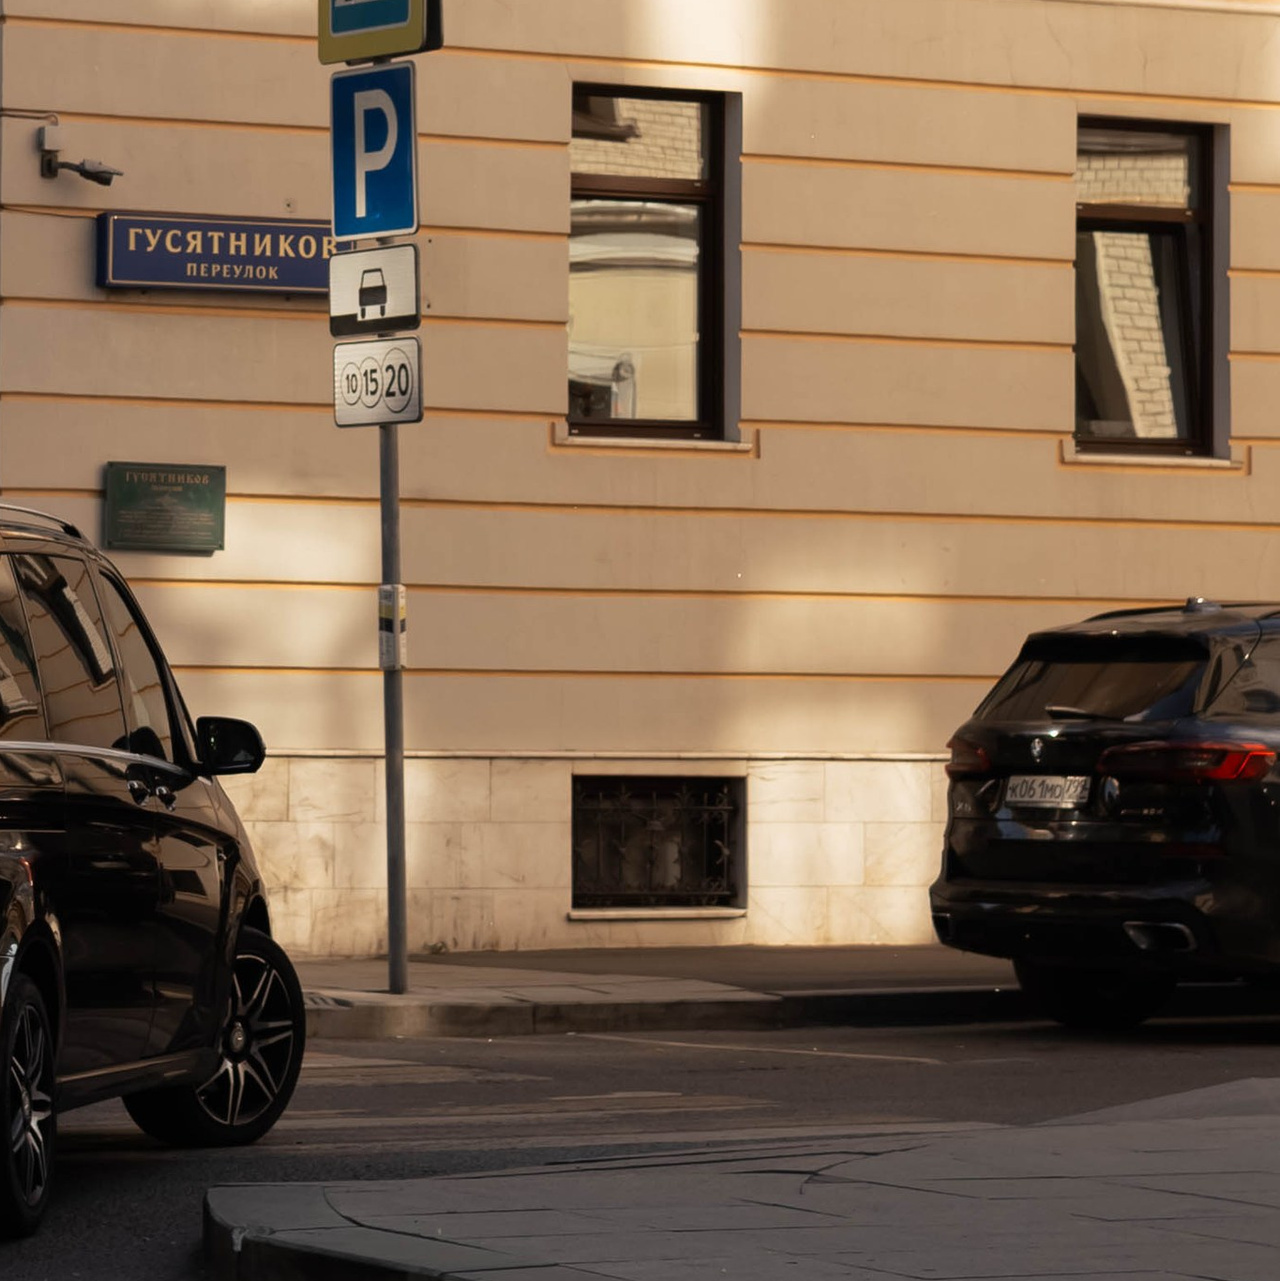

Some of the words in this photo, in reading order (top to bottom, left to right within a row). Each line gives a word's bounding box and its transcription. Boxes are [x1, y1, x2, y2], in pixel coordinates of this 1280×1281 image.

[354, 88, 398, 218] P
[128, 228, 337, 259] ГУСЯТНИКОВ
[186, 262, 279, 280] ПЕРЕУЛОК
[345, 373, 359, 395] 10
[363, 368, 379, 397] 15
[385, 362, 409, 398] 20
